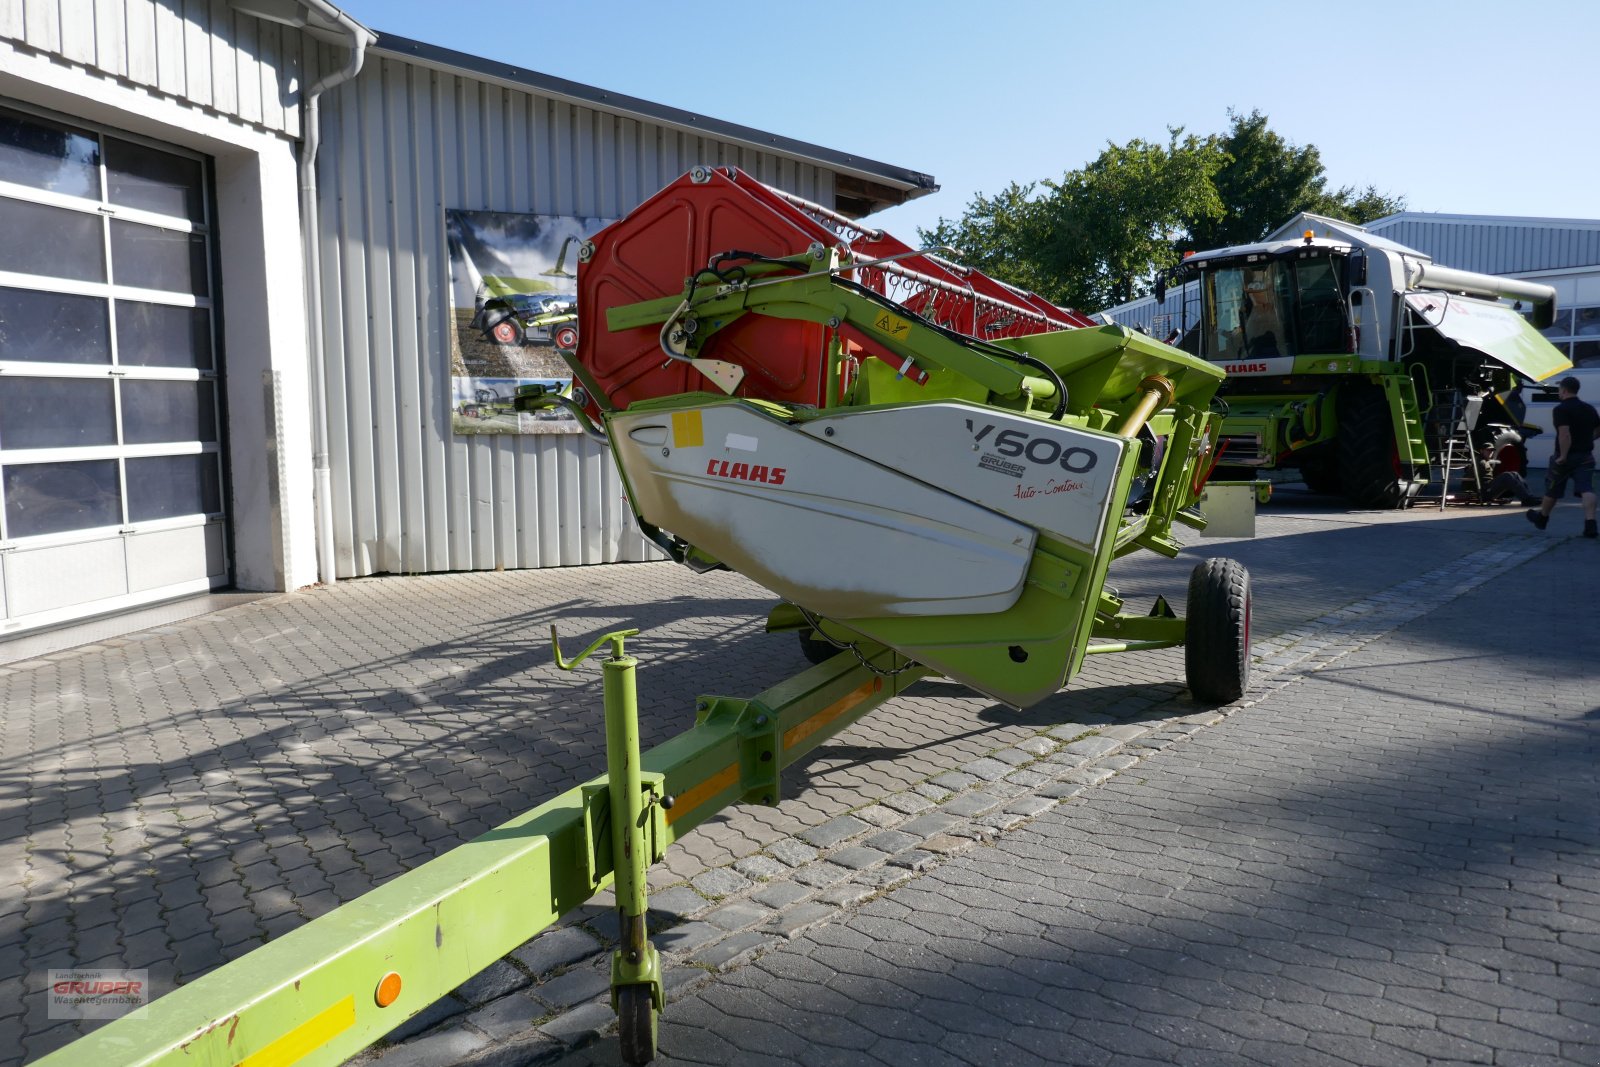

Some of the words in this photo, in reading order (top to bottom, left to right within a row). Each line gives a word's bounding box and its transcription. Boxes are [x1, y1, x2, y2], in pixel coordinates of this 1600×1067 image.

[1225, 363, 1267, 373] CLAAS
[706, 459, 786, 485] CLAAS
[980, 455, 1026, 473] GRUBER
